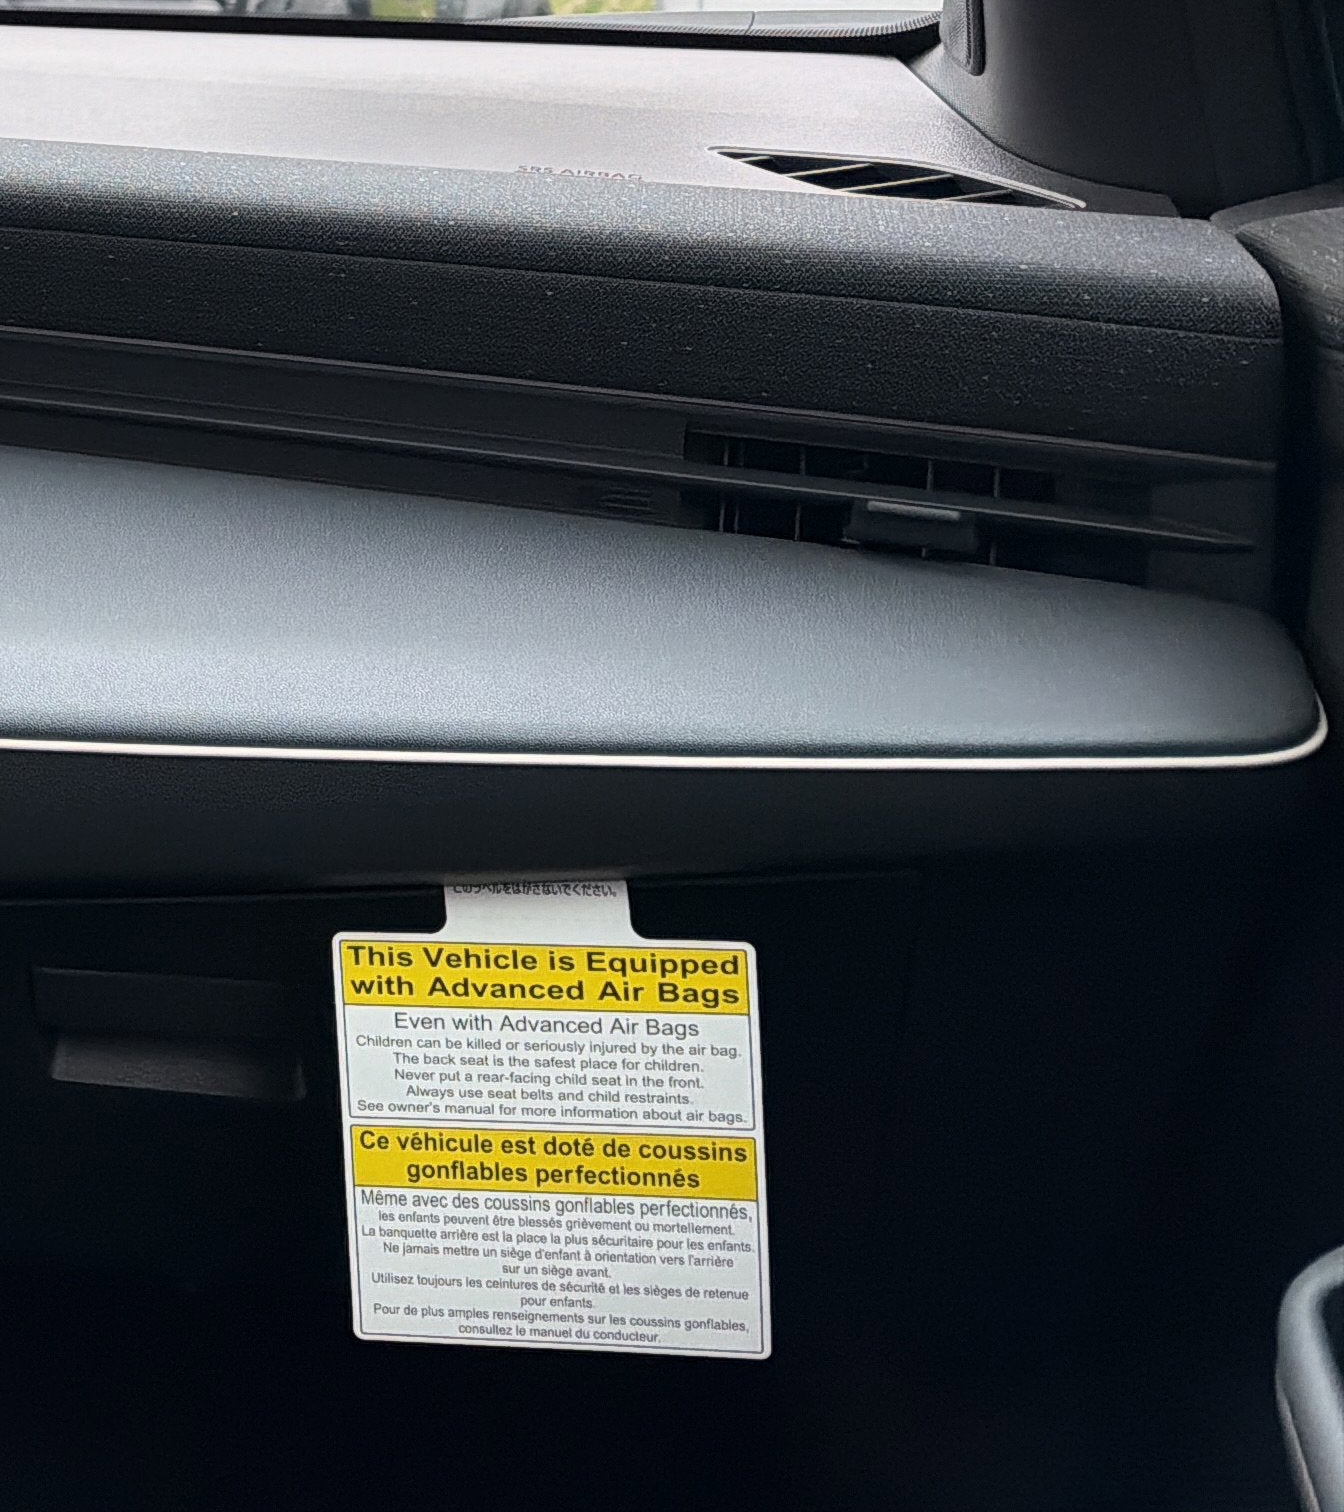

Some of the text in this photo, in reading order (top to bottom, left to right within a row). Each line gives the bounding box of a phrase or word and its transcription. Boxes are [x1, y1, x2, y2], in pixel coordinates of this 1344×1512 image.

[347, 945, 738, 979] This Vehicle is Equipped
[350, 974, 739, 1008] with Advanced Air Bags
[394, 1012, 699, 1040] Even with Advanced Air Bags
[355, 1034, 412, 1047] Children
[416, 1039, 441, 1047] can
[445, 1037, 462, 1048] be
[466, 1037, 501, 1049] killed
[505, 1041, 520, 1050] or
[523, 1039, 585, 1055] seriously
[589, 1041, 636, 1056] injured
[640, 1043, 658, 1057] by
[661, 1043, 684, 1055] the
[688, 1044, 707, 1056] air
[395, 1052, 419, 1063] The
[423, 1053, 456, 1064] back
[459, 1054, 489, 1065] seat
[492, 1055, 504, 1066] is
[508, 1055, 529, 1066] the
[533, 1056, 576, 1068] safest
[579, 1058, 617, 1072] place
[621, 1059, 640, 1070] for
[394, 1068, 436, 1080] Never
[438, 1070, 461, 1084] put
[464, 1073, 472, 1081] a
[477, 1071, 551, 1087] rear-facing
[554, 1073, 587, 1085] child
[591, 1075, 622, 1086] seat
[625, 1076, 637, 1086] in
[639, 1076, 664, 1087] the
[405, 1084, 454, 1100] Always
[458, 1089, 483, 1098] use
[487, 1087, 516, 1099] seat
[520, 1088, 553, 1100] belts
[557, 1089, 584, 1101] and
[587, 1090, 620, 1102] child
[356, 1099, 384, 1110] See
[387, 1100, 440, 1112] owner's
[444, 1102, 494, 1114] manual
[498, 1104, 516, 1115] for
[520, 1107, 556, 1116] more
[560, 1106, 638, 1119] information
[642, 1108, 682, 1121] about
[685, 1110, 704, 1121] air
[359, 1130, 747, 1162] Ce véhicule est doté de coussins
[406, 1158, 699, 1192] gonflables perfectionnés
[361, 1188, 407, 1206] Même
[411, 1194, 448, 1207] avec
[451, 1192, 479, 1209] des
[483, 1193, 550, 1212] coussins
[554, 1196, 635, 1218] gonflables
